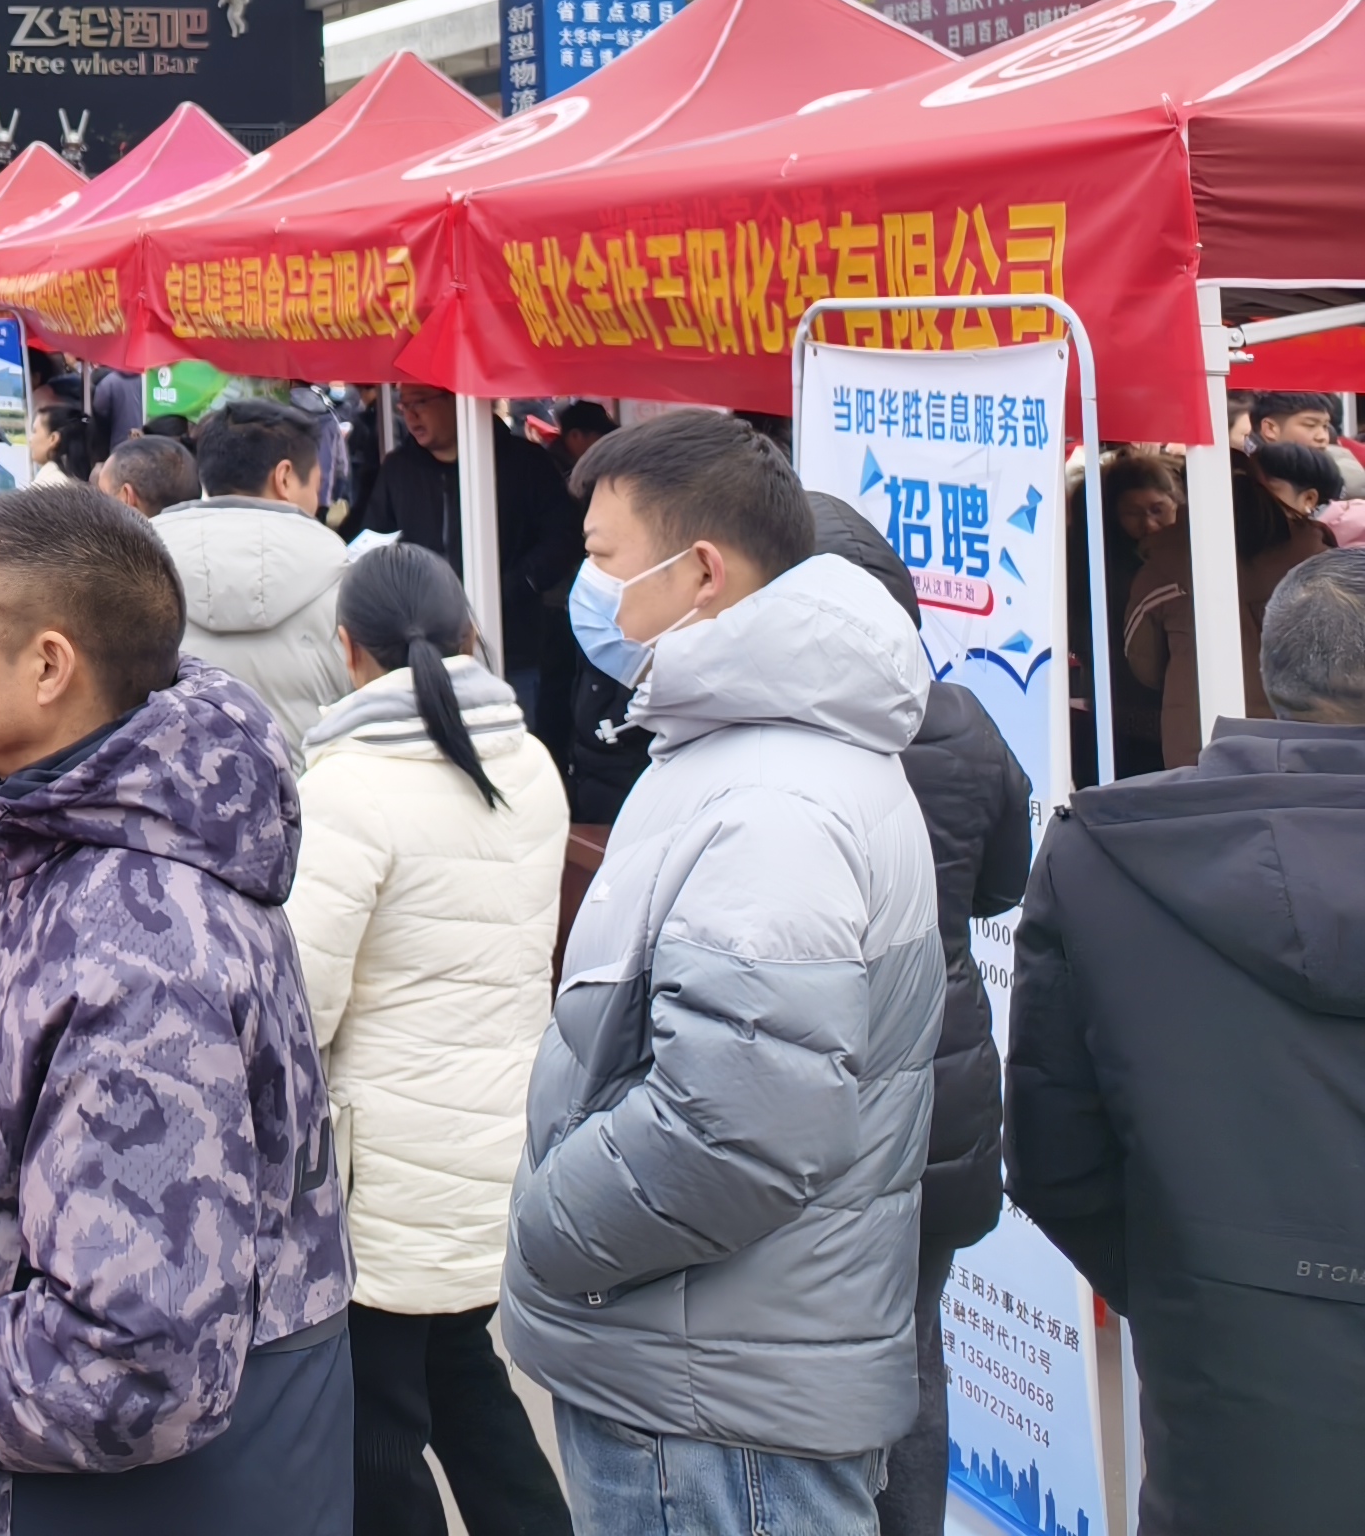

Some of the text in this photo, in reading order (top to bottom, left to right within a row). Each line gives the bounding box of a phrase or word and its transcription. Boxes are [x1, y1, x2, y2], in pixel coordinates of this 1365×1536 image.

[7, 51, 199, 76] Free wheel Bar
[8, 6, 209, 49] 飞轮酒吧
[507, 2, 537, 115] 新型物流
[833, 385, 1049, 450] 当阳华胜信息服务部
[884, 474, 991, 578] 招聘
[957, 1374, 1050, 1449] 19072754134
[960, 1340, 1055, 1413] 13545830658
